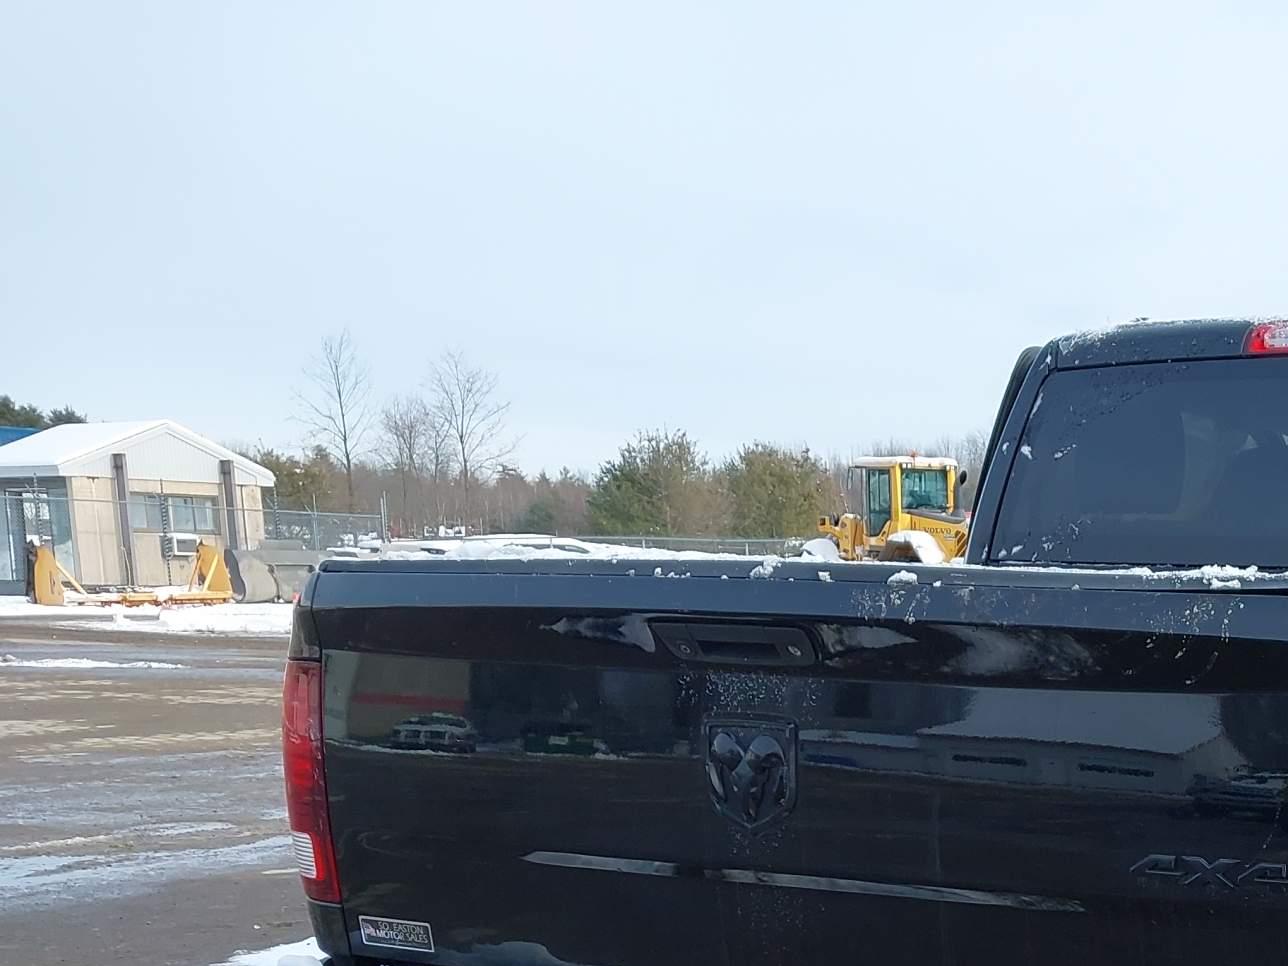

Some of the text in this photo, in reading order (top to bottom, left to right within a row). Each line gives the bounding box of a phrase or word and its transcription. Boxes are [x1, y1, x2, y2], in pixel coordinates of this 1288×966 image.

[925, 527, 952, 535] VOLVO
[393, 923, 424, 934] EASTON
[376, 929, 405, 941] MOTOR
[406, 933, 429, 944] SALES
